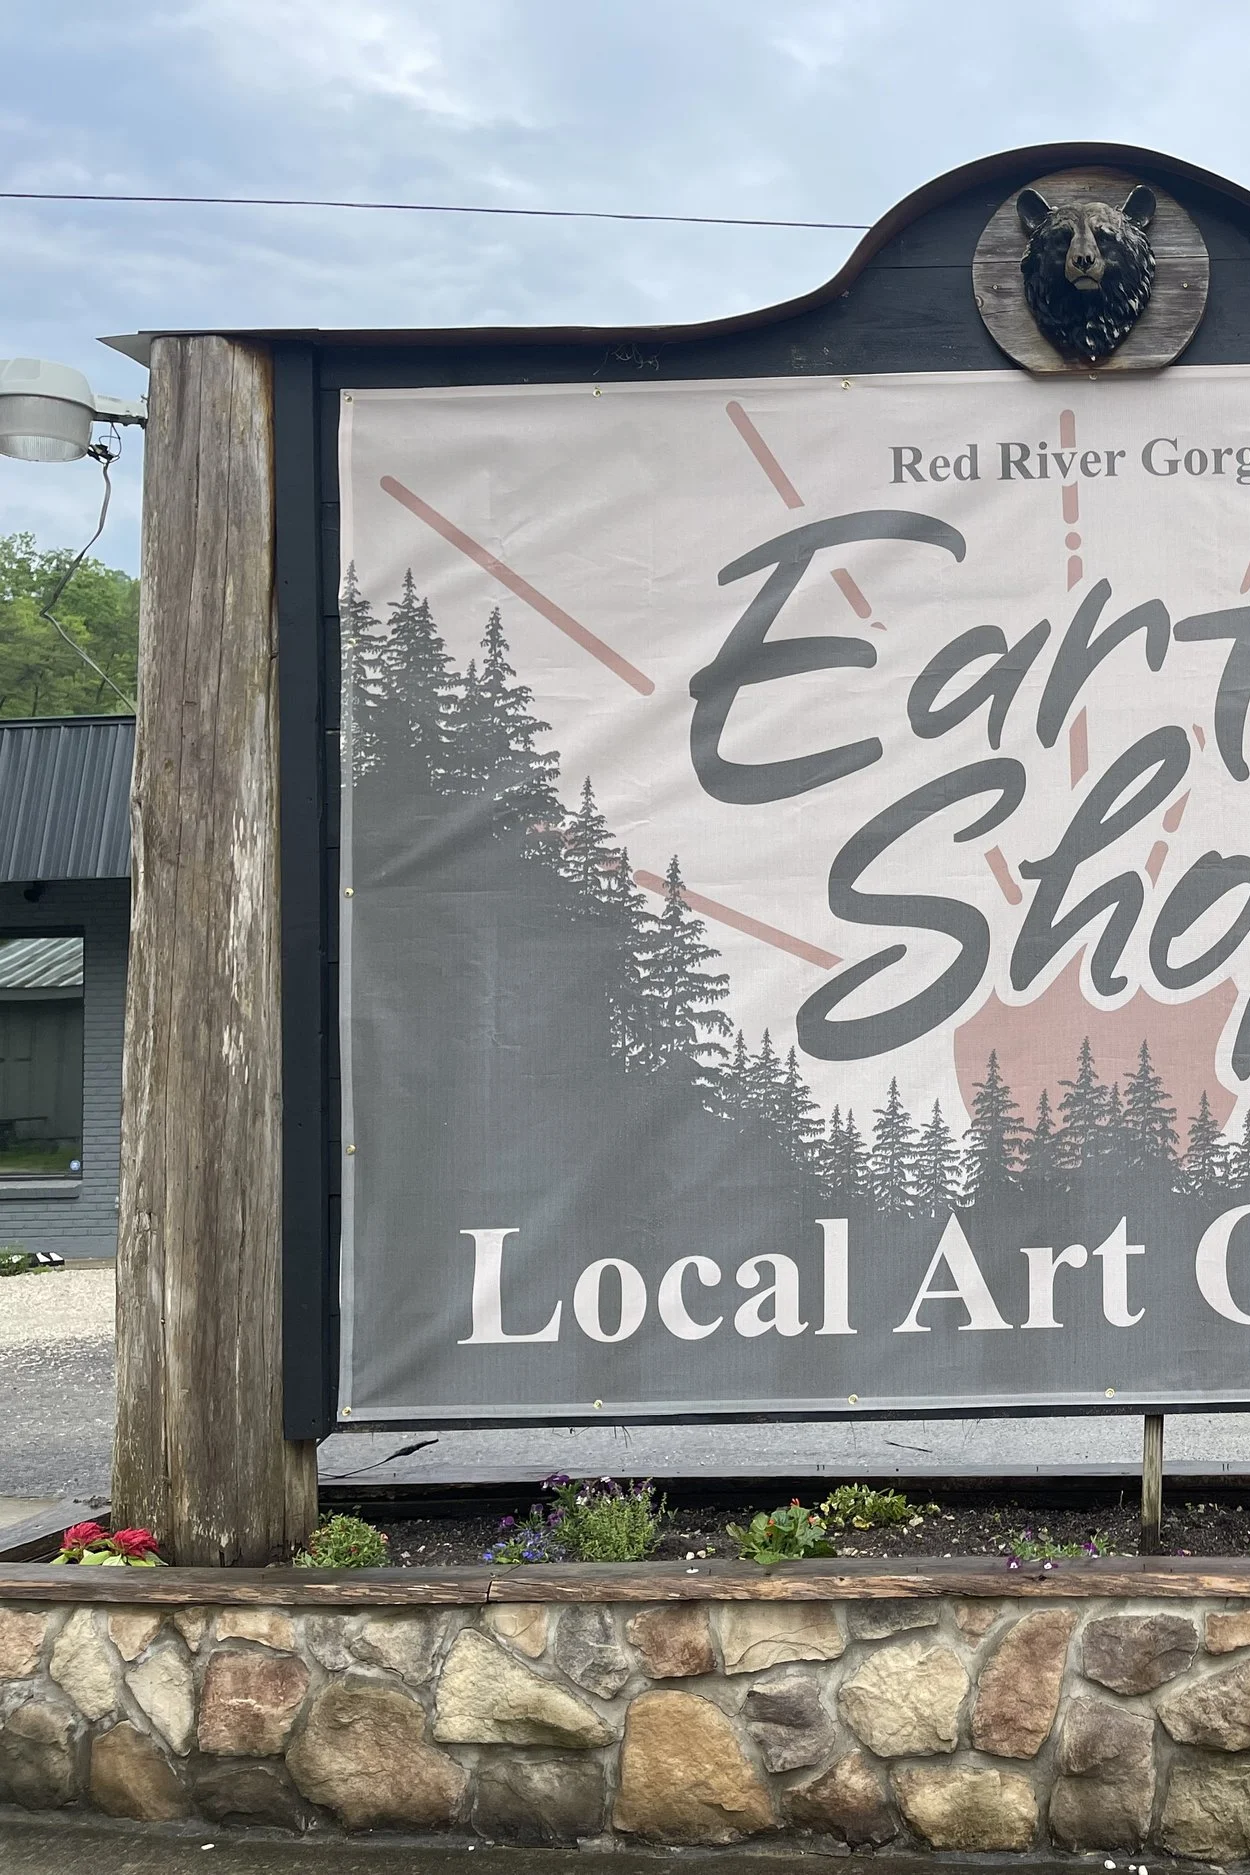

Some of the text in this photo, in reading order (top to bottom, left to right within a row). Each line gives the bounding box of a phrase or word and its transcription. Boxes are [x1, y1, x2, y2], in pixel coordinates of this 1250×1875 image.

[888, 443, 981, 484] Red
[996, 440, 1126, 481] River
[457, 1217, 858, 1346] Local
[892, 1212, 1146, 1334] Art
